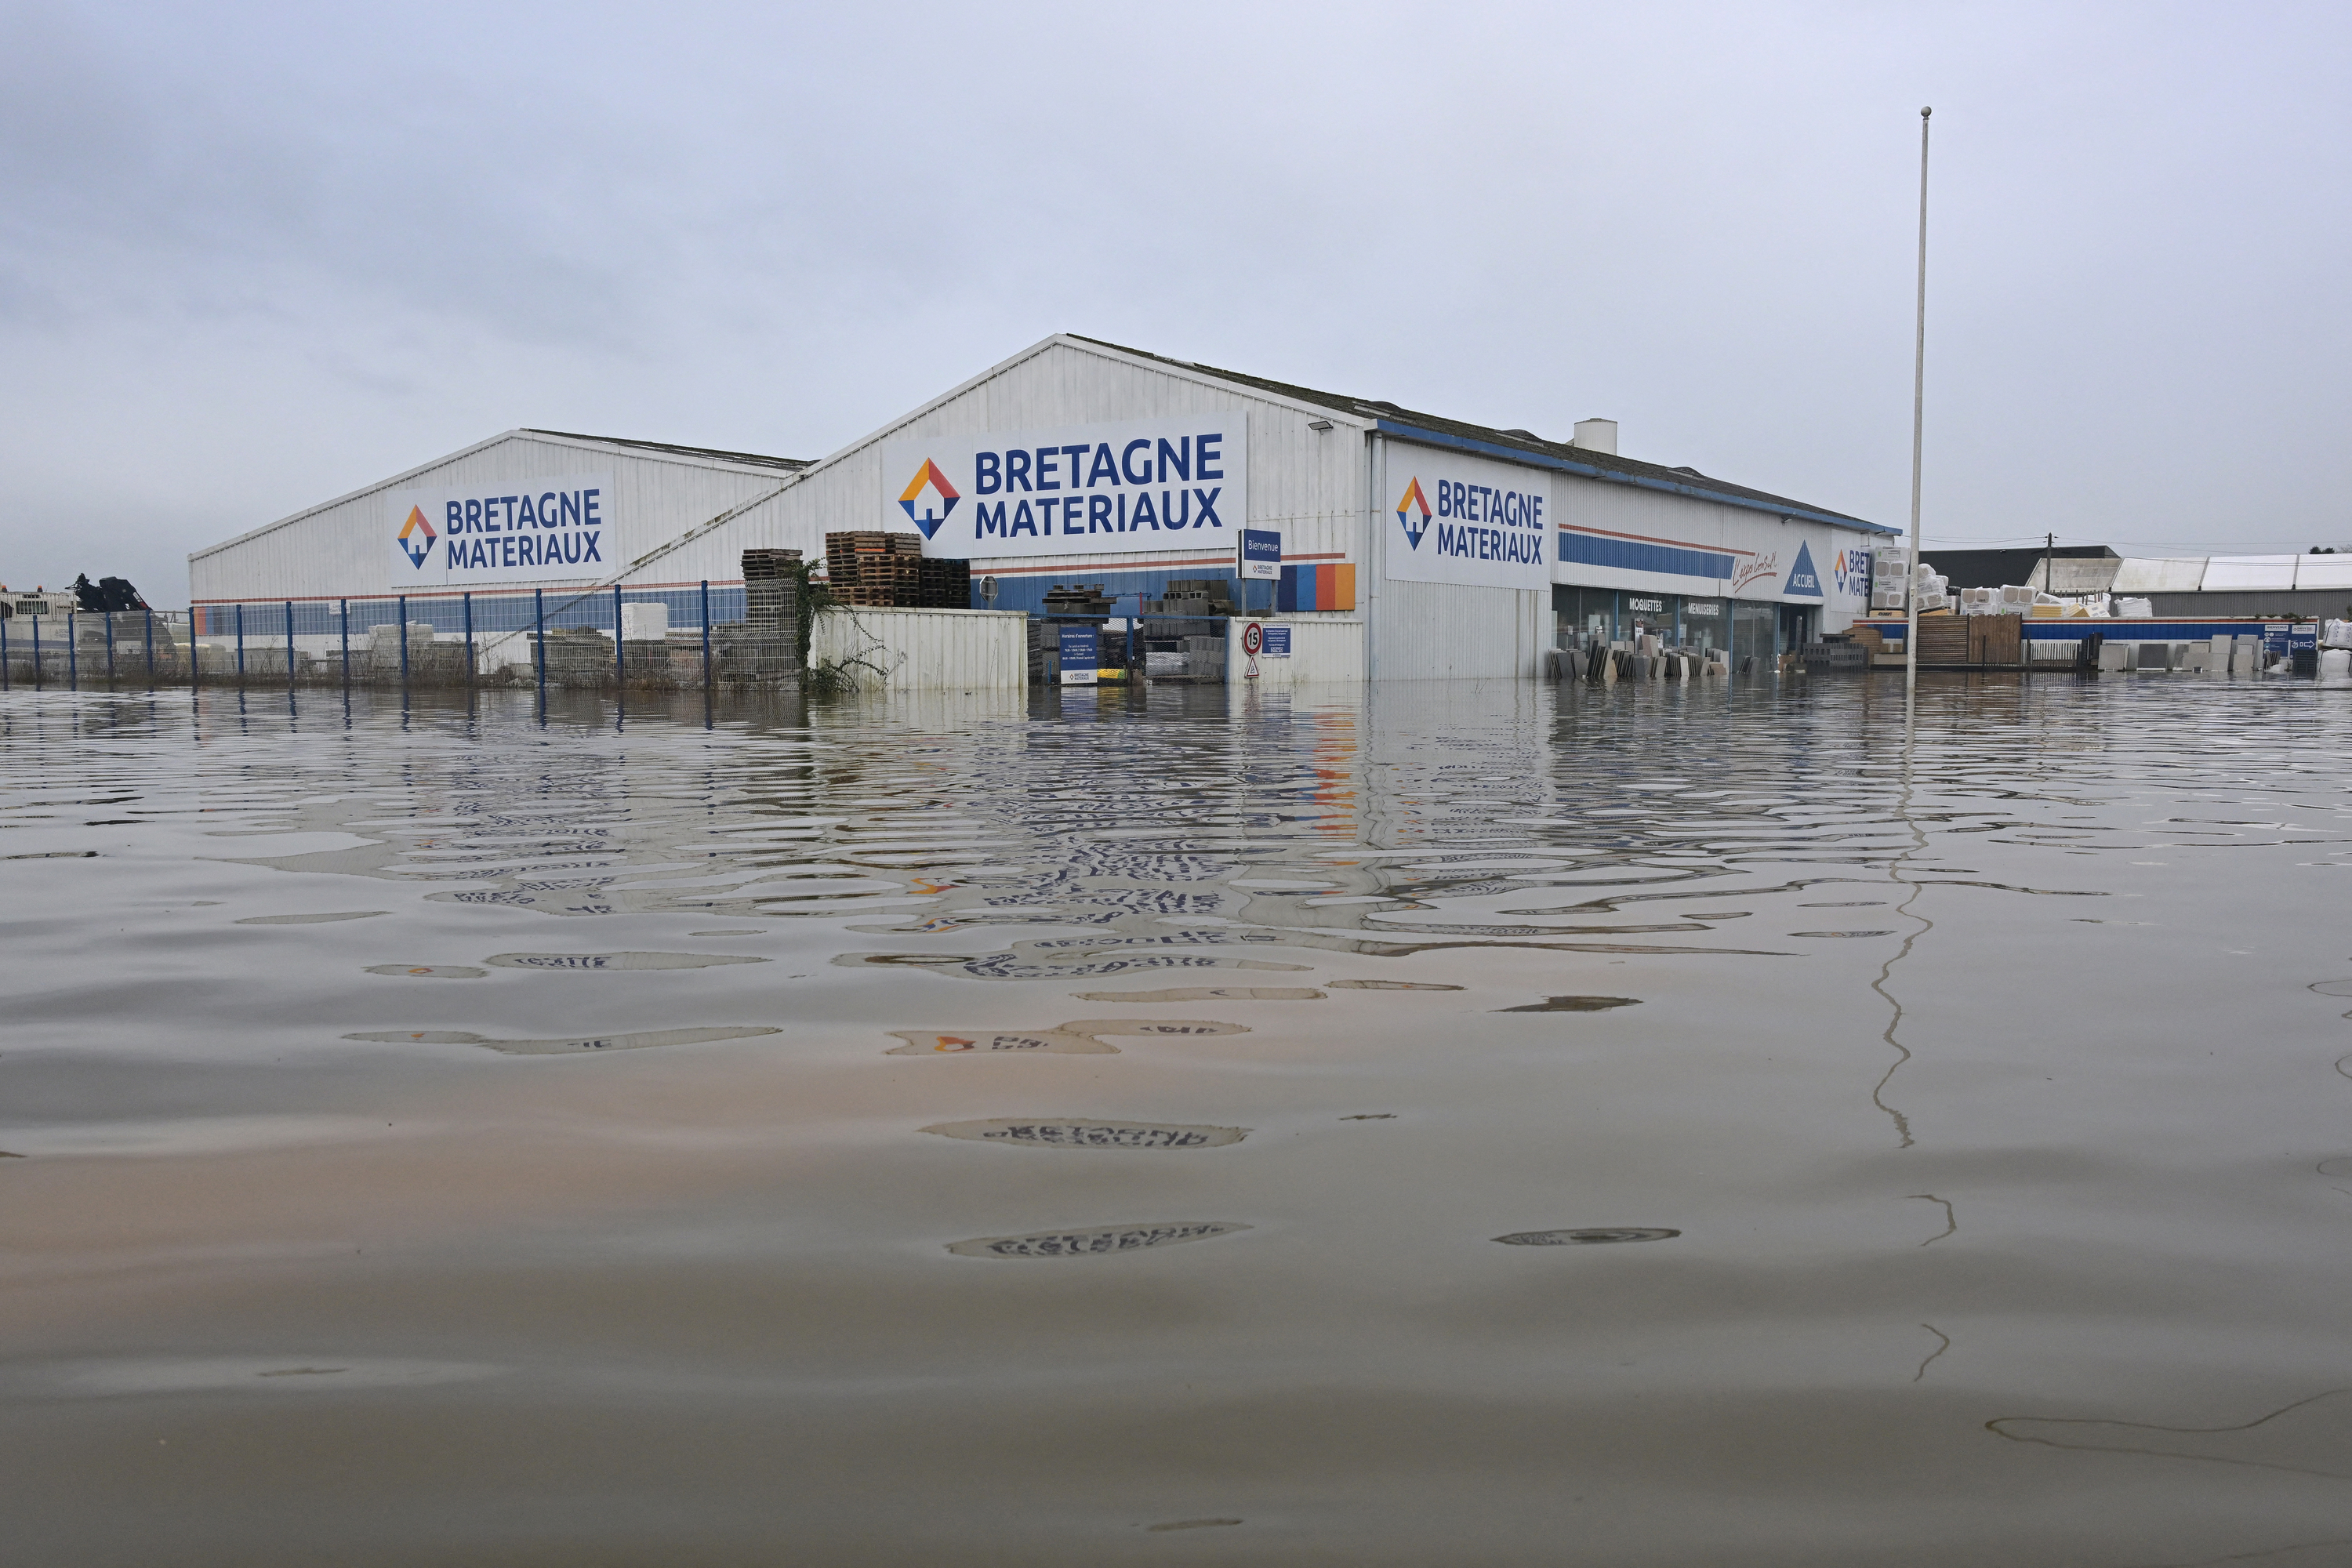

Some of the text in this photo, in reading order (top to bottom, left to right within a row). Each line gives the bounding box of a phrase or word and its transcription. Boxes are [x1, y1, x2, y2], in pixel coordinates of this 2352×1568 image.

[975, 434, 1225, 495] BRETAGNE
[446, 489, 602, 535] BRETAGNE
[975, 488, 1224, 539] MATERIAUX
[1438, 479, 1544, 530] BRETAGNE
[448, 531, 602, 570] MATERIAUX
[1248, 539, 1279, 552] Bienvenue
[1437, 523, 1543, 565] MATERIAUX
[1792, 573, 1815, 588] ACCUEIL
[1629, 597, 1662, 612] MOQUETTES
[1688, 602, 1719, 616] MENUISERIES
[1248, 632, 1258, 646] 15
